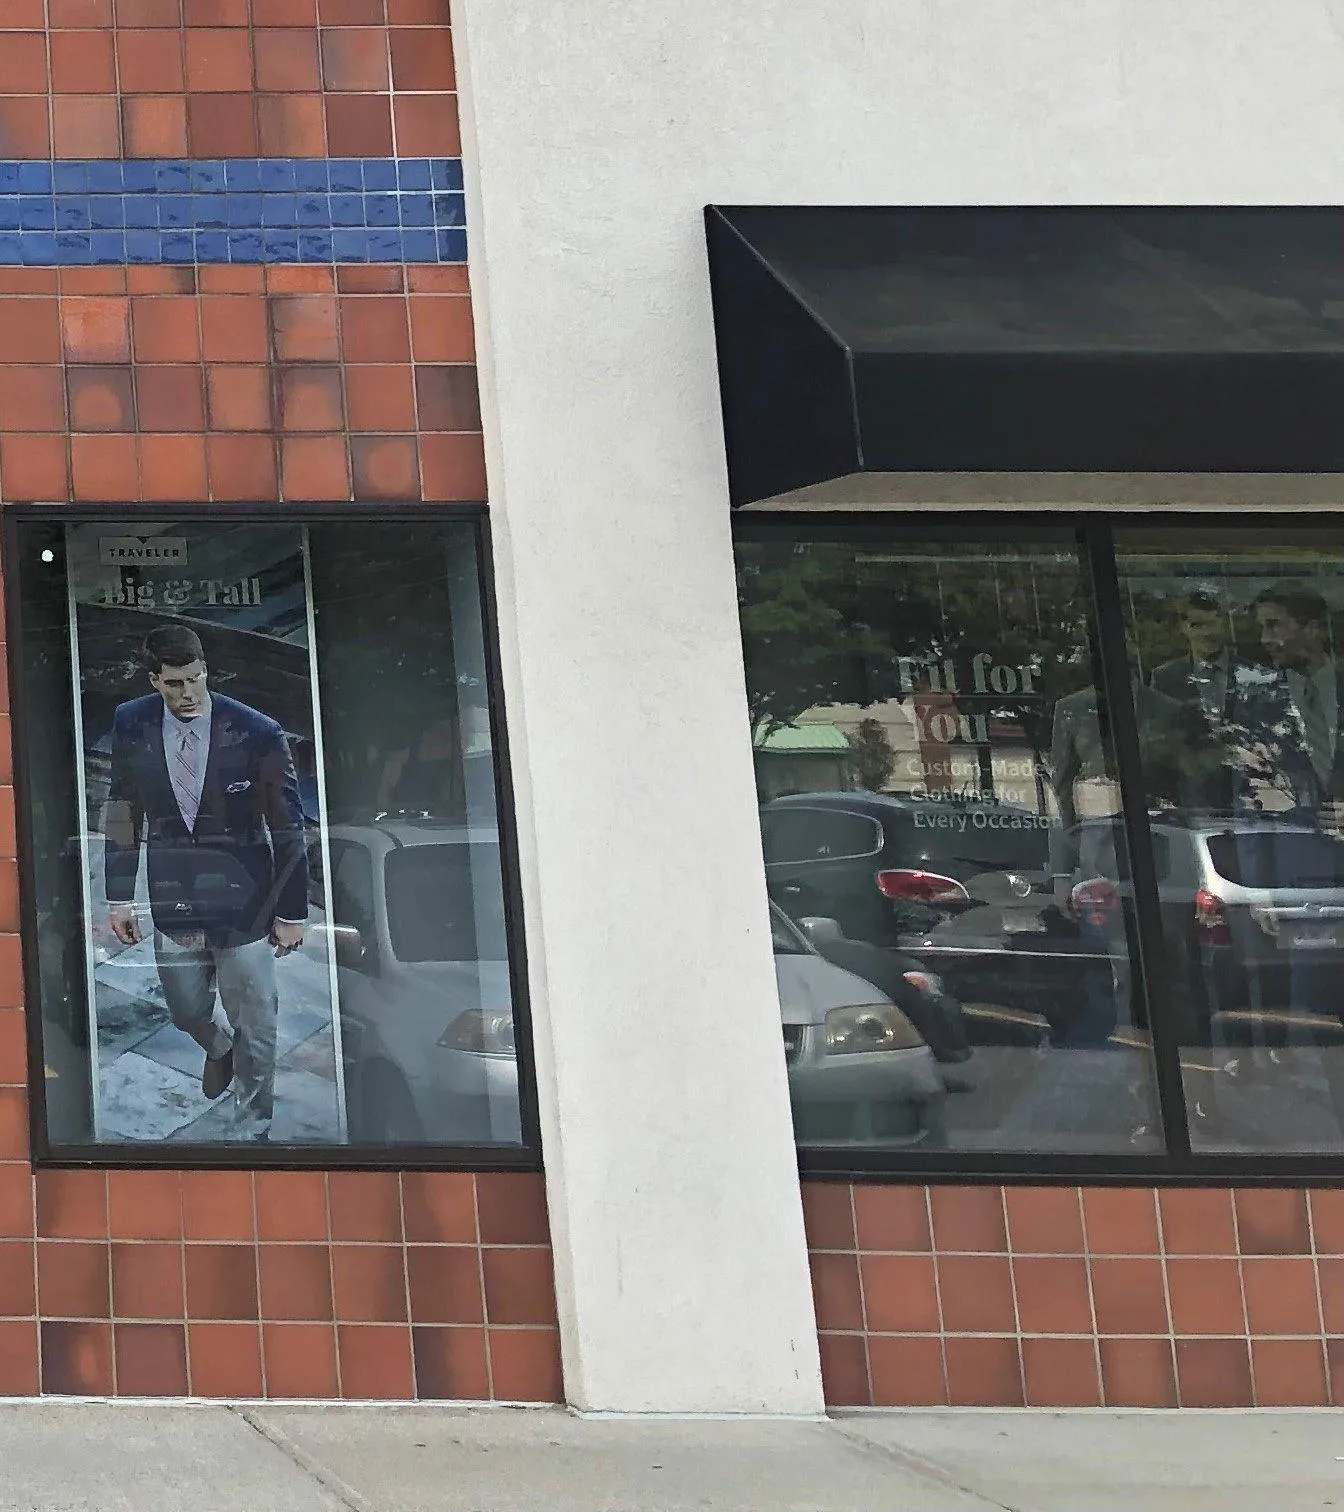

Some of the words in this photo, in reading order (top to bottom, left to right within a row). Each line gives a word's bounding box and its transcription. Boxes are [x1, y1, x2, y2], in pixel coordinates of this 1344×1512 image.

[109, 548, 179, 558] TRAVELER
[104, 577, 156, 608] Big
[164, 578, 193, 605] &
[199, 577, 262, 605] Tall
[972, 652, 1042, 694] for
[904, 704, 992, 744] You
[914, 810, 968, 833] Every
